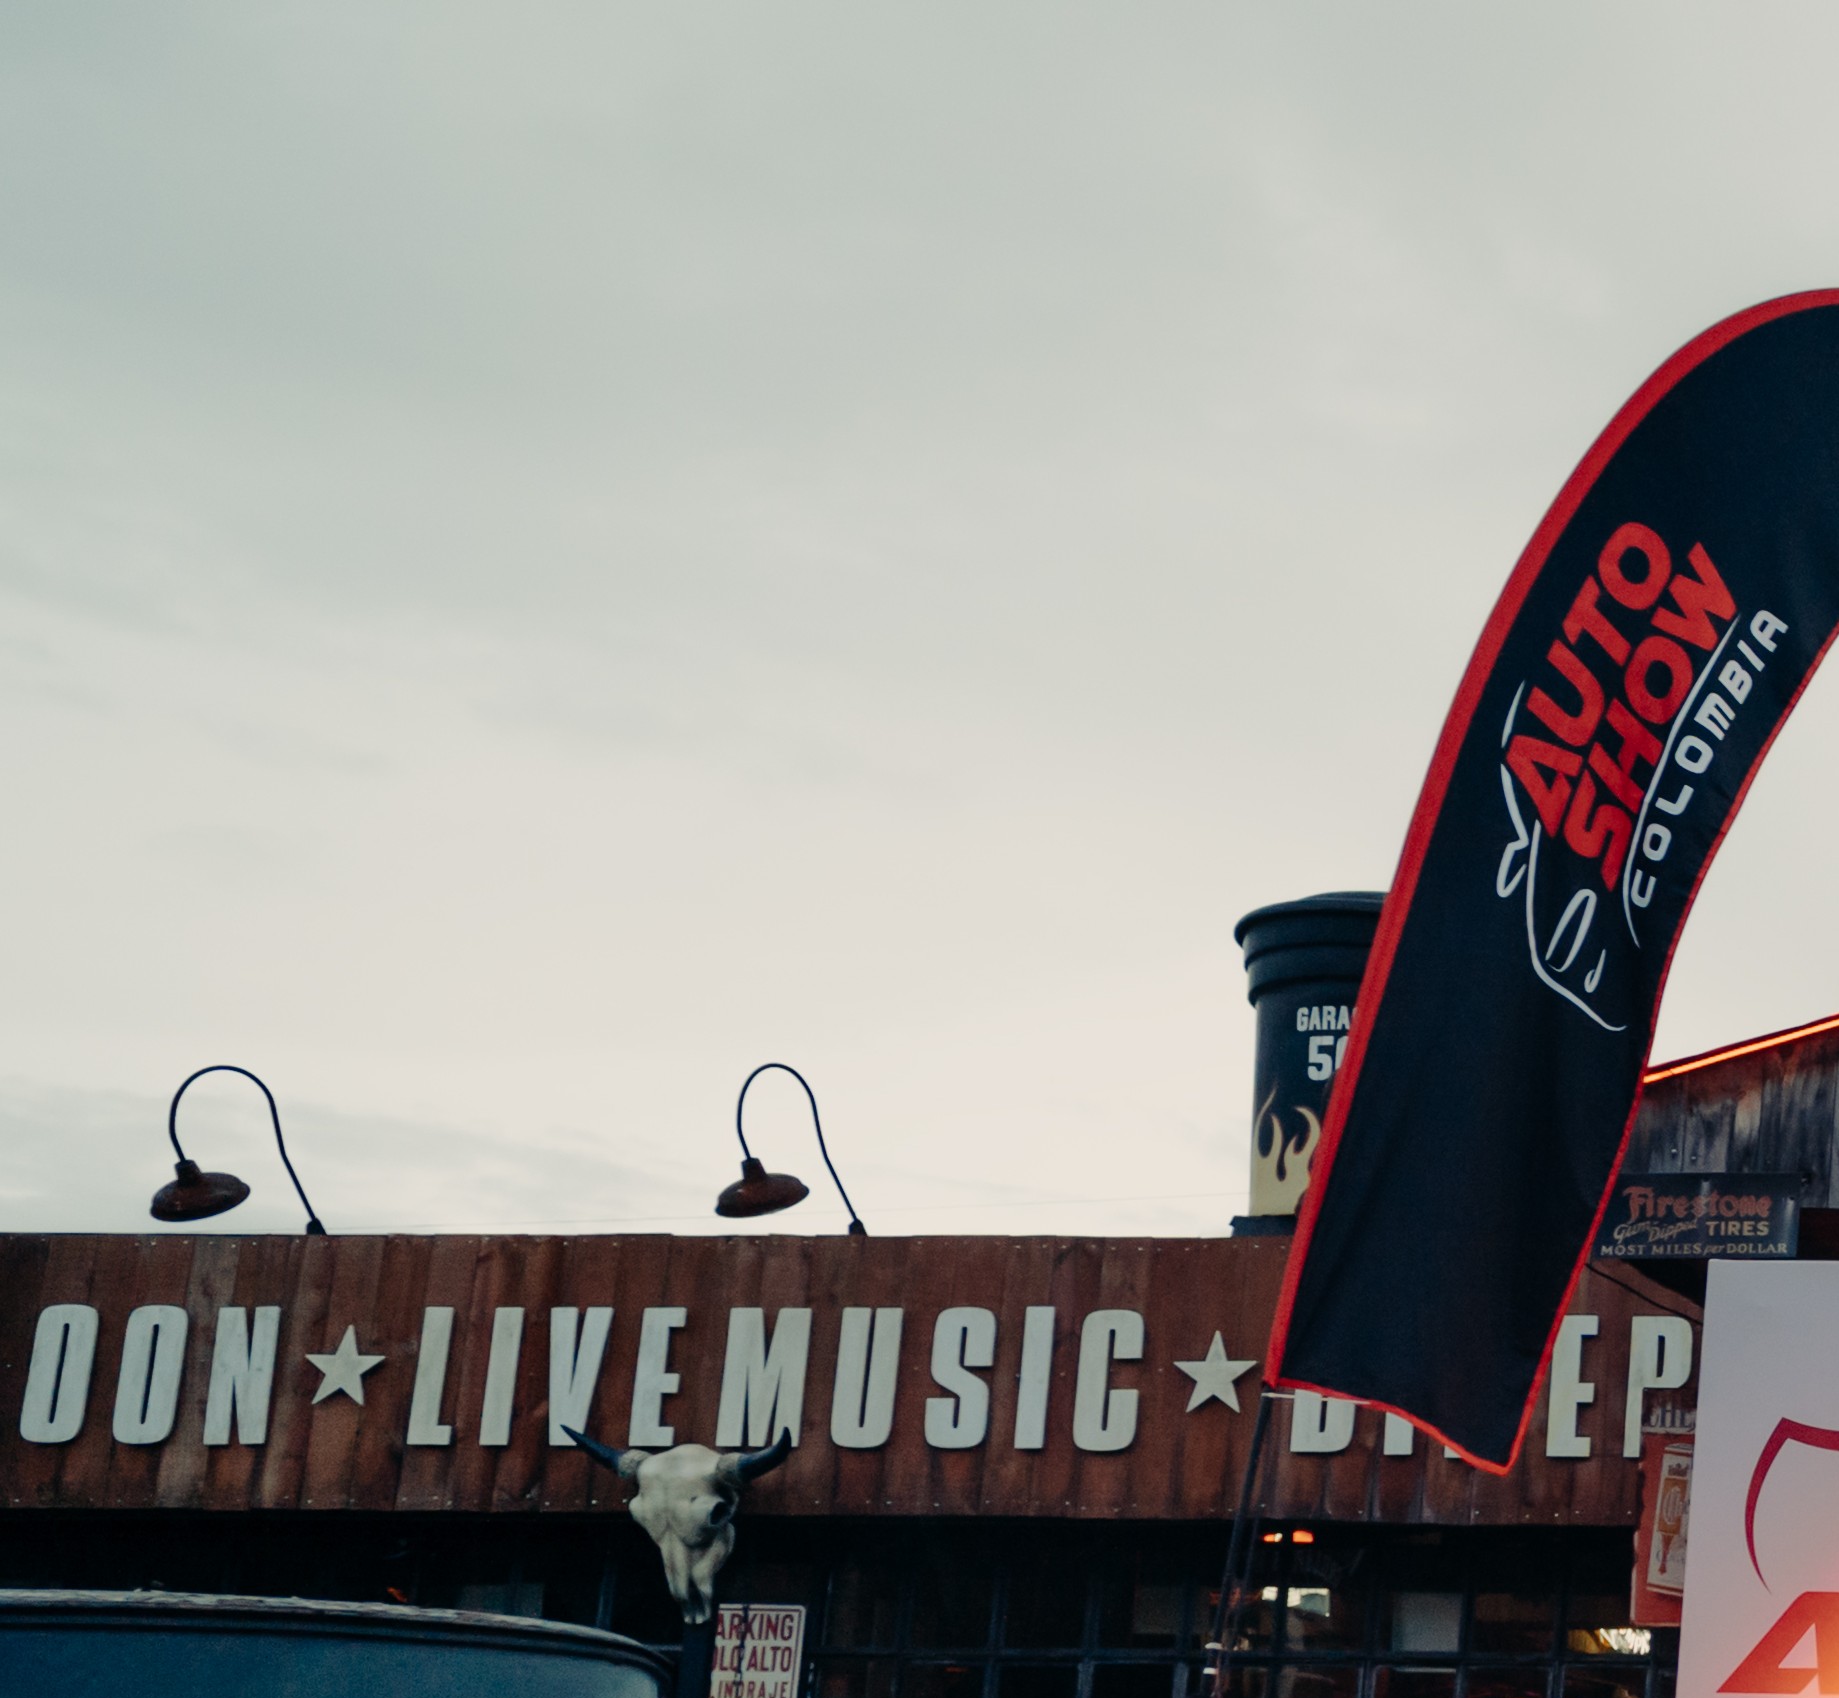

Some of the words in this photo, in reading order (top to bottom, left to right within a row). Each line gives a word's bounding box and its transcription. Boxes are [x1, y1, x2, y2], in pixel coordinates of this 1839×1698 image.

[1507, 522, 1671, 837] AUTO
[1564, 541, 1738, 891] SHOW
[1631, 610, 1788, 908] COLOMBIA
[1296, 1005, 1358, 1032] GARA
[1622, 1185, 1773, 1221] Firestone
[1706, 1220, 1770, 1236] TIRES
[1601, 1244, 1647, 1256] MOST
[1651, 1243, 1701, 1255] MILES
[1726, 1242, 1788, 1255] DOLLAR
[19, 1304, 282, 1446] OON
[406, 1306, 687, 1448] LIVE
[716, 1305, 1146, 1453] MUSIC
[715, 1613, 794, 1640] ARKING
[746, 1646, 793, 1672] ALTO
